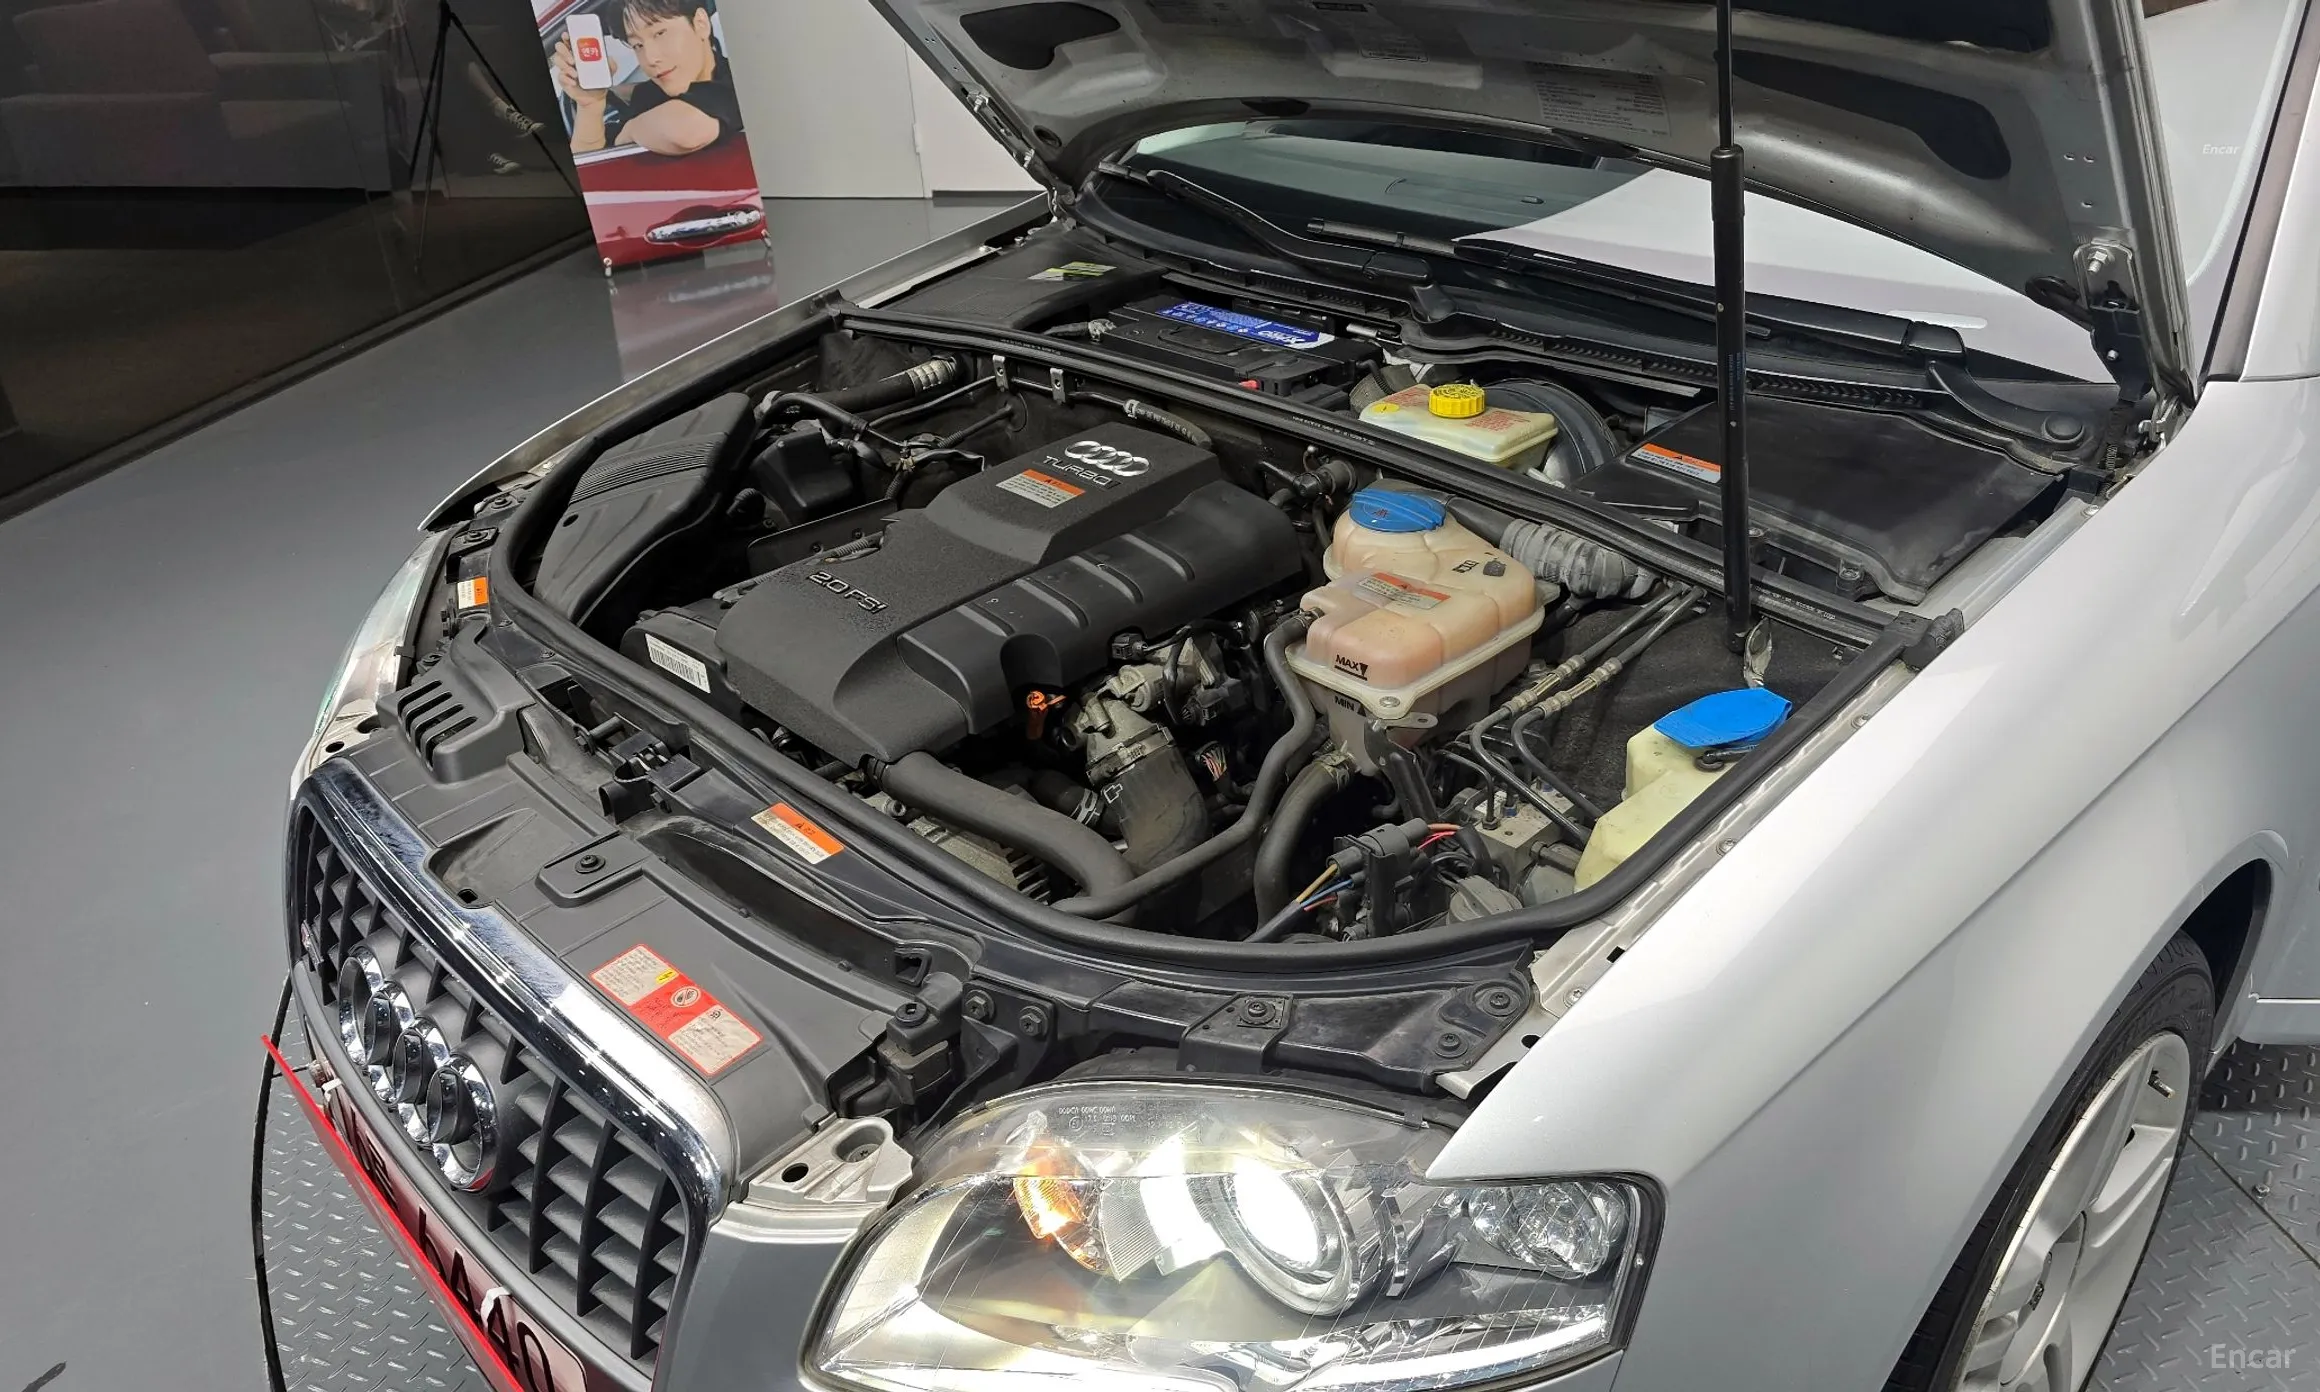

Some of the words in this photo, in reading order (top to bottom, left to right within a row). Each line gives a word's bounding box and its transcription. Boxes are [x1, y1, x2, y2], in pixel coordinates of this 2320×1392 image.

[1043, 455, 1112, 486] TURBO
[1335, 654, 1359, 671] MAX
[1334, 695, 1355, 711] MIN
